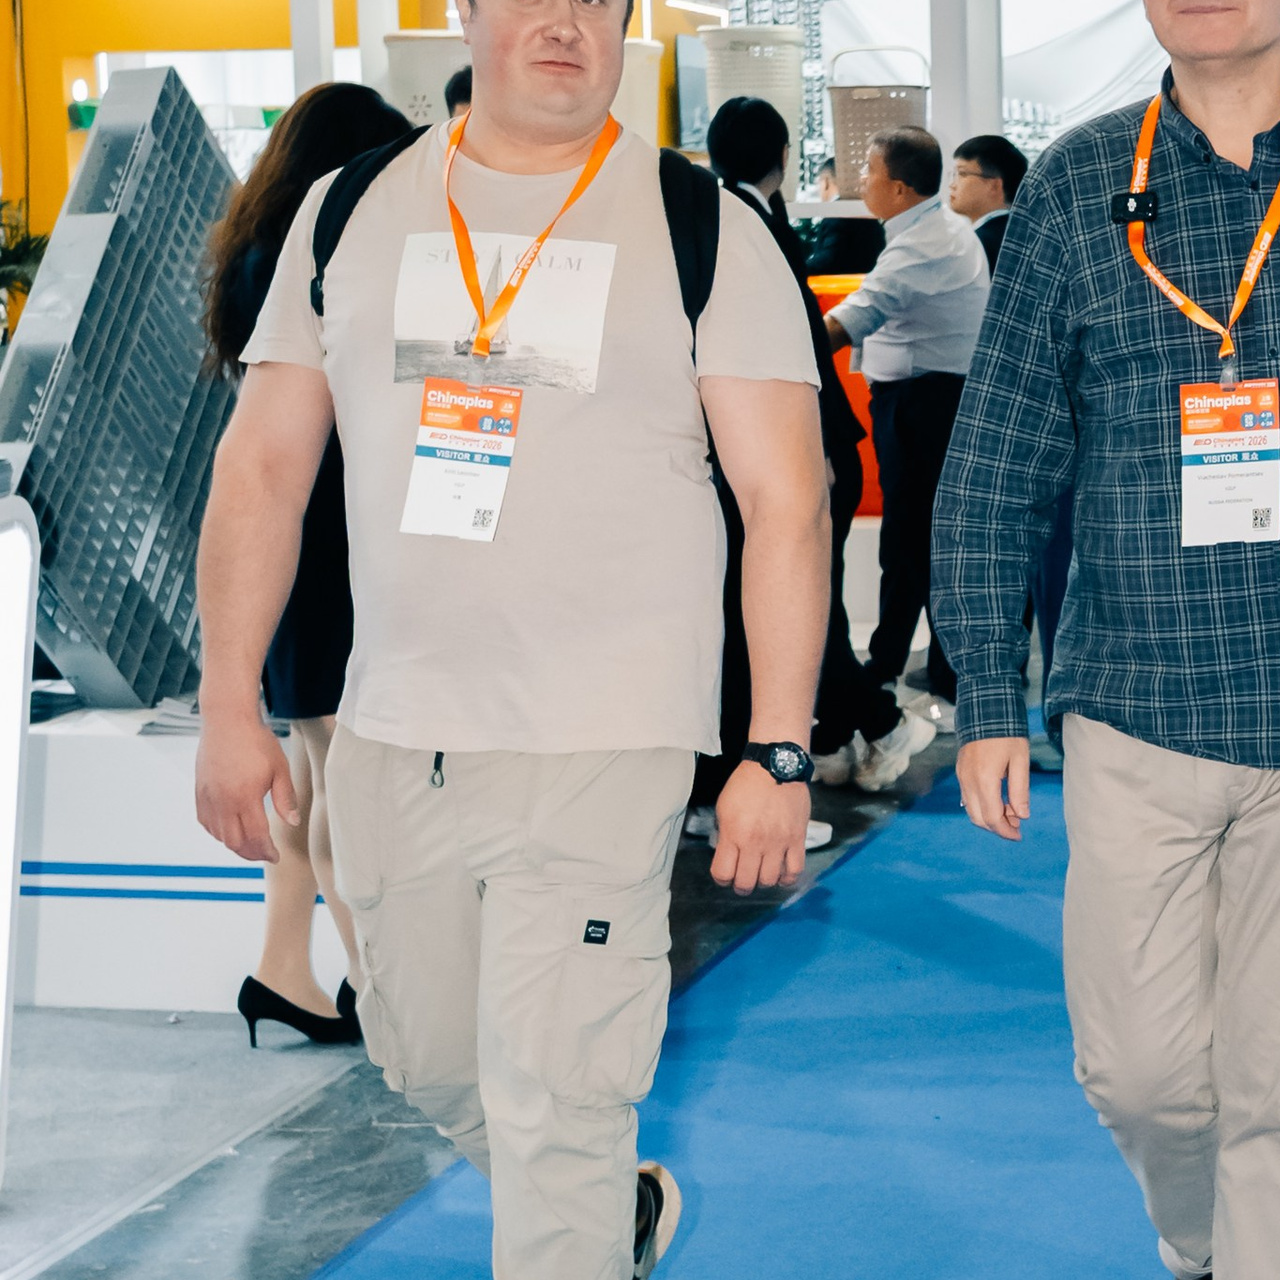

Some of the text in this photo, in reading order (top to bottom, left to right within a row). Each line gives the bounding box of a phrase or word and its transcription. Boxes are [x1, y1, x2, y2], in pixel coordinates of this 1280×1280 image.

[427, 390, 494, 410] Chinaplas
[1184, 394, 1252, 410] Chinaplas
[1248, 435, 1268, 446] 2026
[436, 449, 471, 461] VISITOR
[1202, 453, 1239, 464] VISITOR
